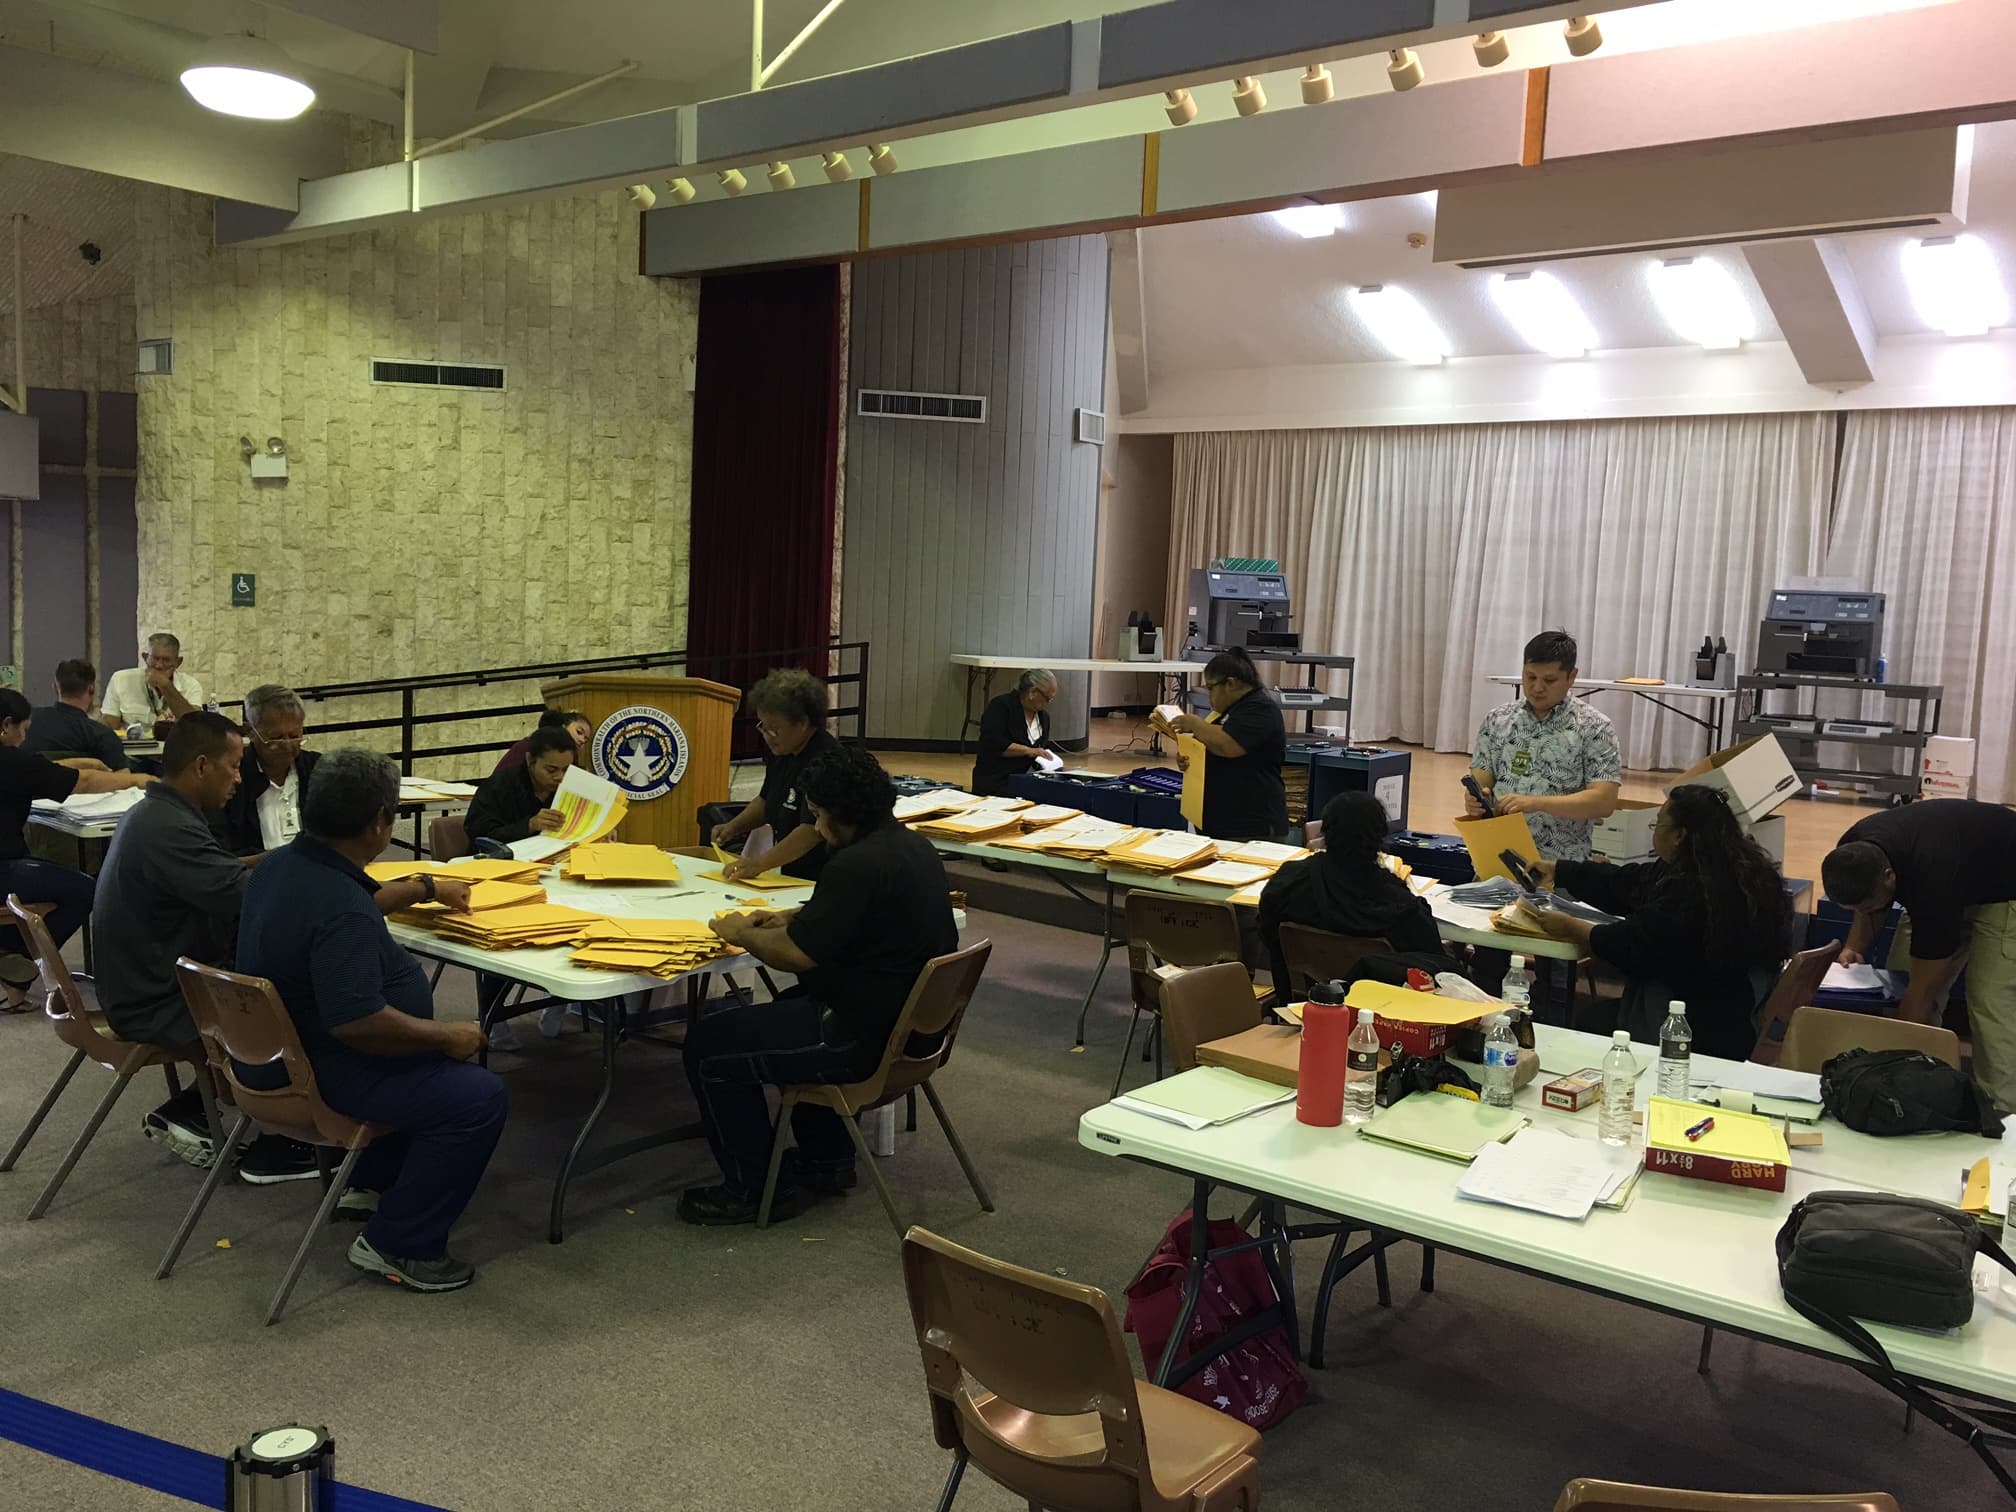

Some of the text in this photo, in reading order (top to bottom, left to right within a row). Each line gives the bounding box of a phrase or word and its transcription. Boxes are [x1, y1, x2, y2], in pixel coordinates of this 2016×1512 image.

[593, 707, 687, 777] COMMONWEALTH OF THE NORTHERN MARIANA ISLANDS
[628, 788, 664, 799] ICIAL SEAL
[1731, 1167, 1775, 1179] HARD
